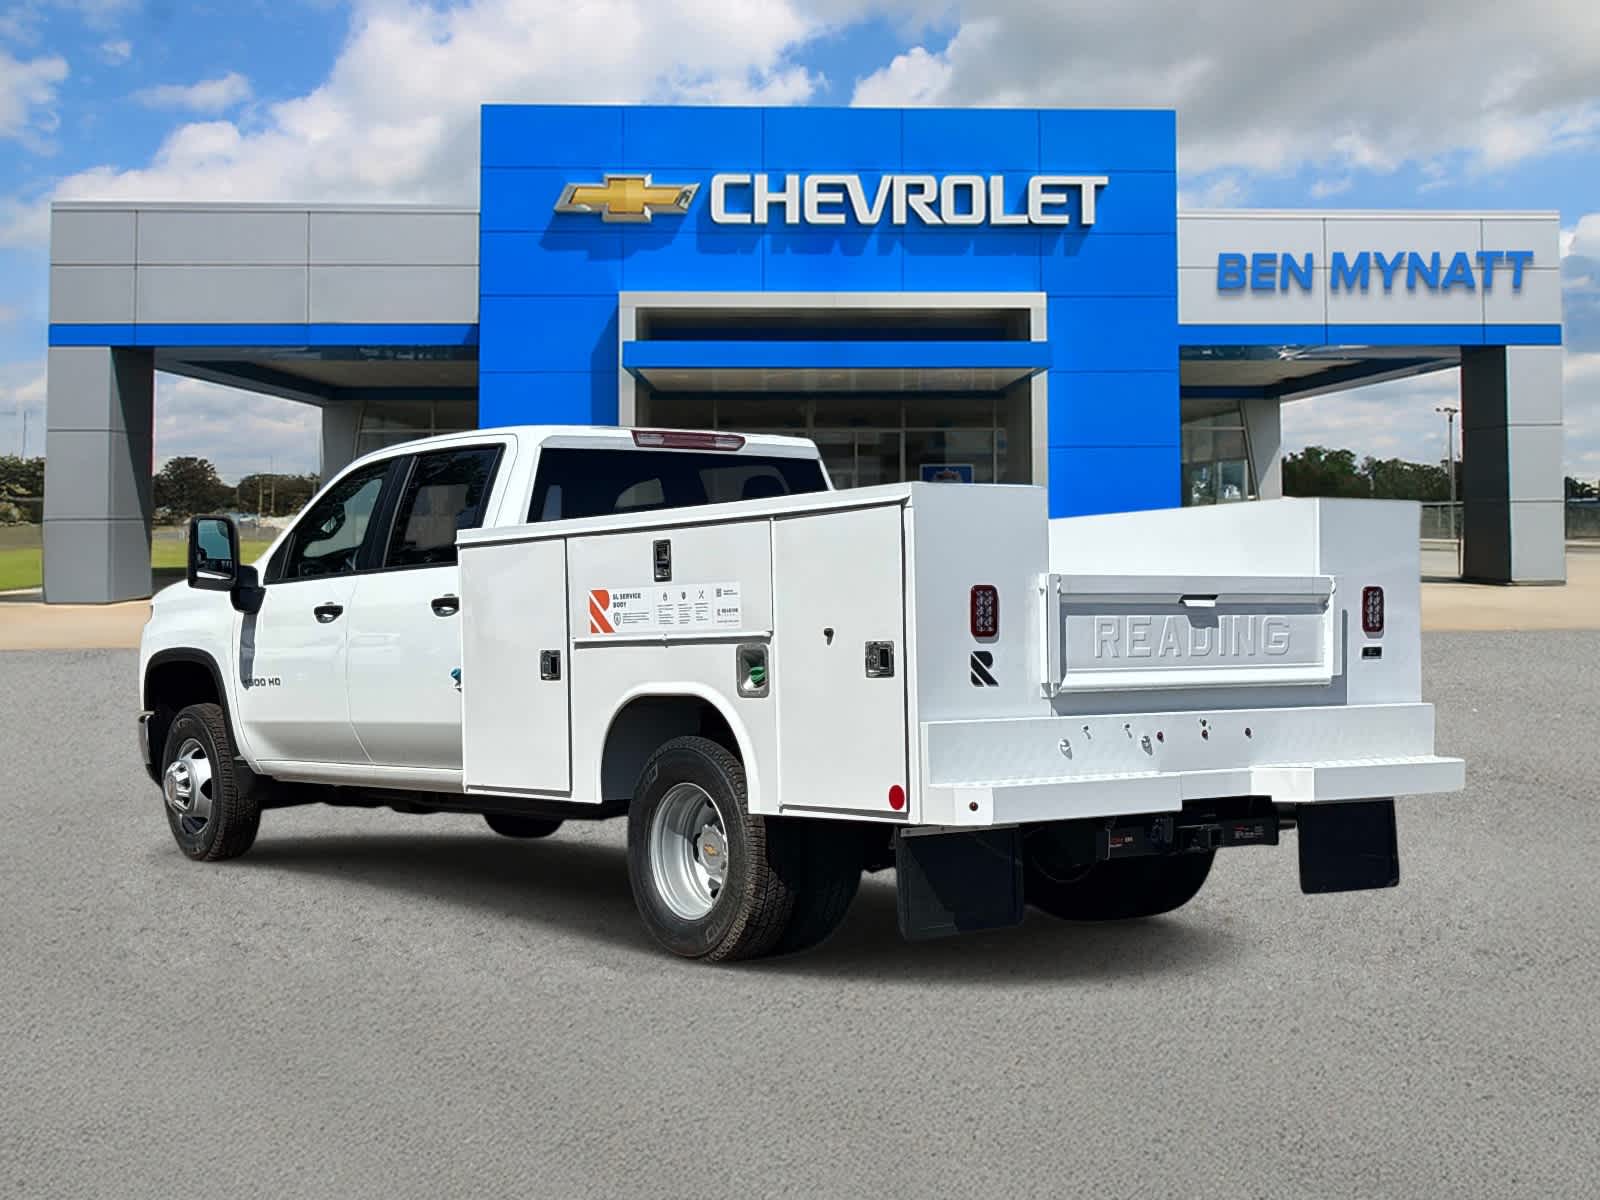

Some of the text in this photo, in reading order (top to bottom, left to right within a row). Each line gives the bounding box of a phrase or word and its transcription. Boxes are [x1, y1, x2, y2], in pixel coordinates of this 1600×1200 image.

[710, 174, 1109, 226] CHEVROLET
[1216, 251, 1534, 290] BEN MYNATT
[612, 601, 627, 609] BODY
[620, 592, 642, 600] SERVICE
[1093, 614, 1291, 659] READING
[268, 677, 281, 686] HD
